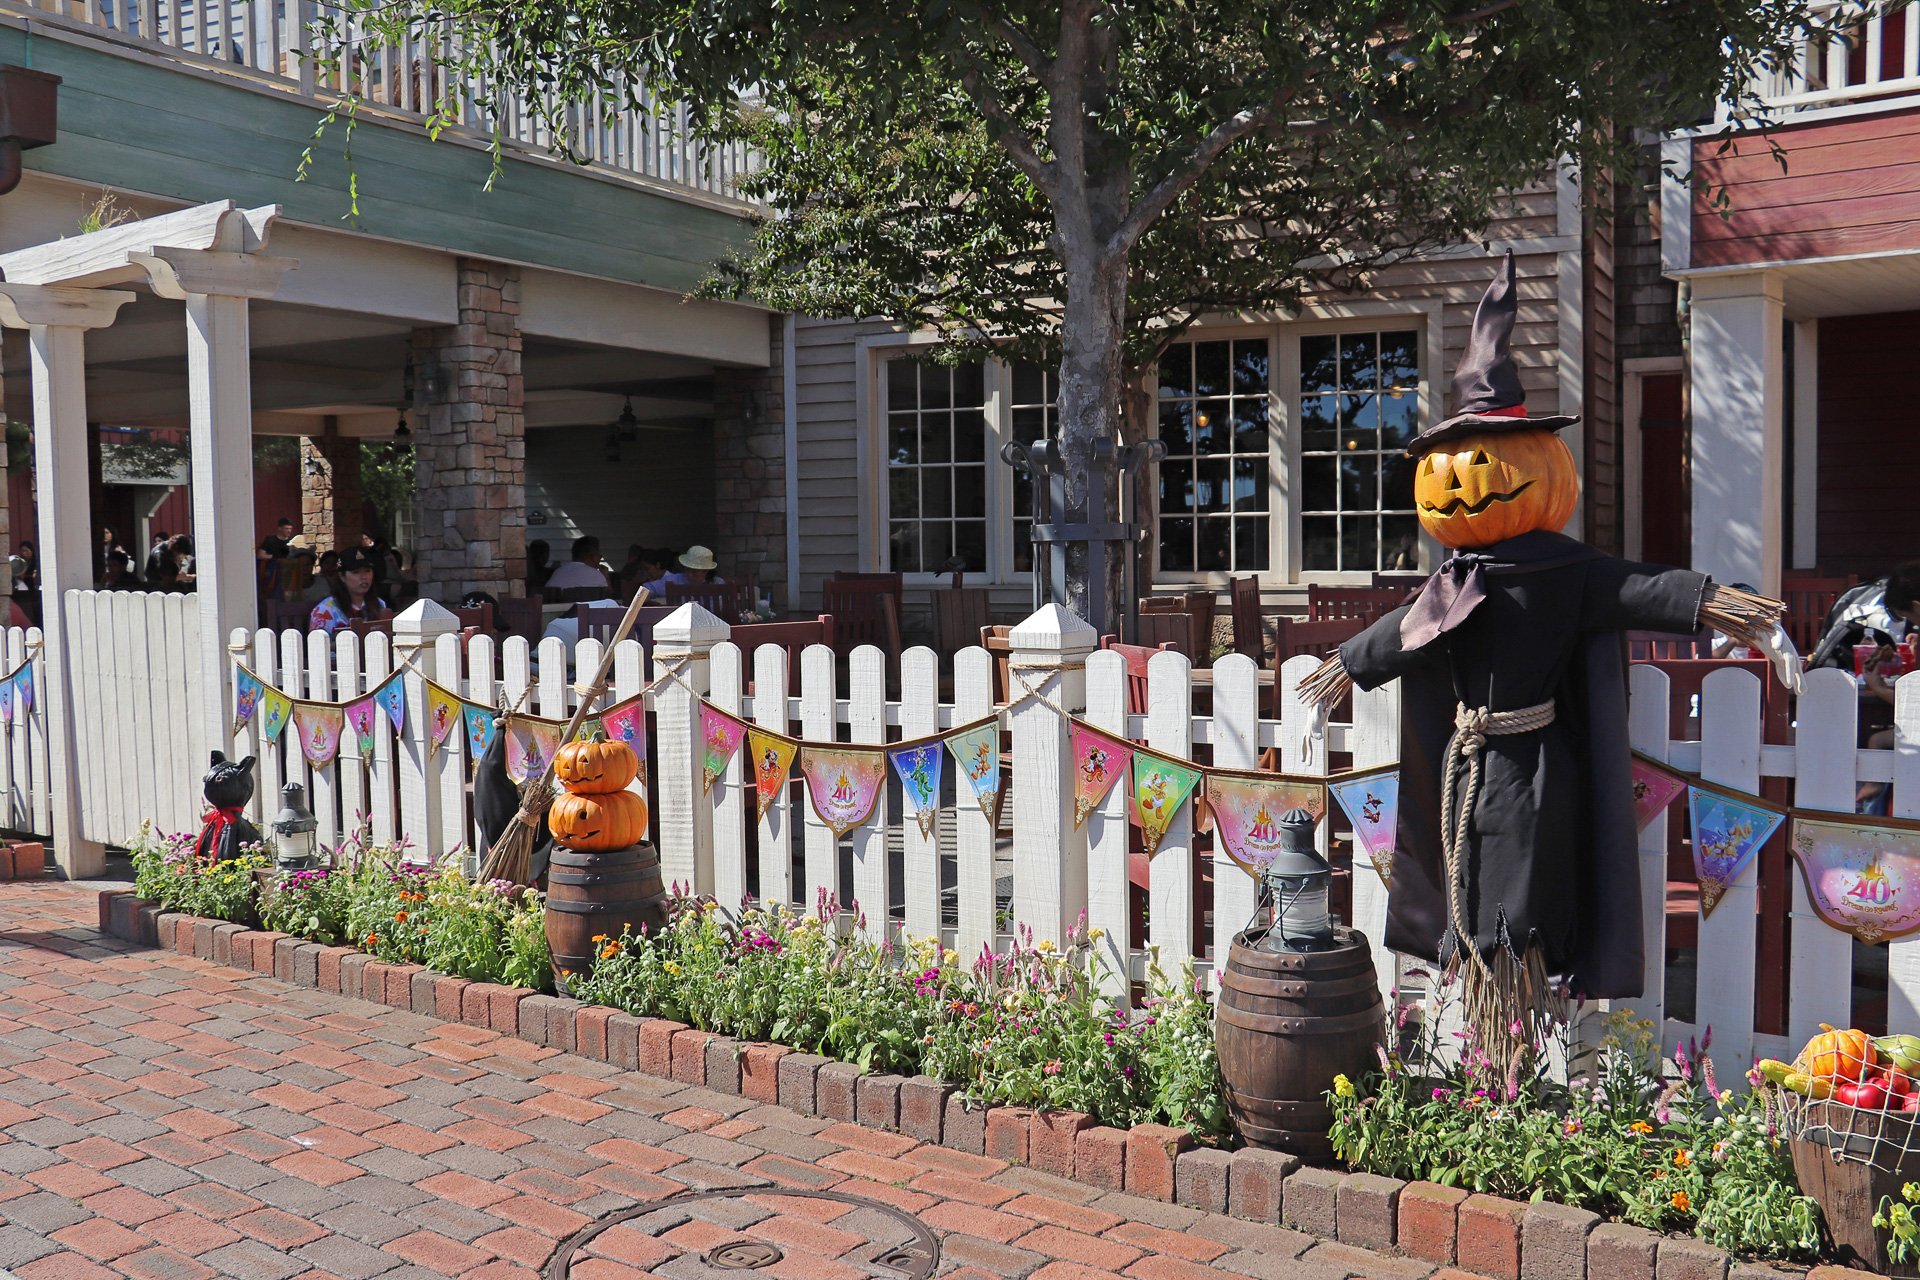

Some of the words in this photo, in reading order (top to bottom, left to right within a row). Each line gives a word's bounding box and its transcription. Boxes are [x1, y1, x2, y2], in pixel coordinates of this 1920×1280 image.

[831, 780, 853, 804] 40
[1248, 816, 1278, 843] 40
[1847, 871, 1890, 905] 40
